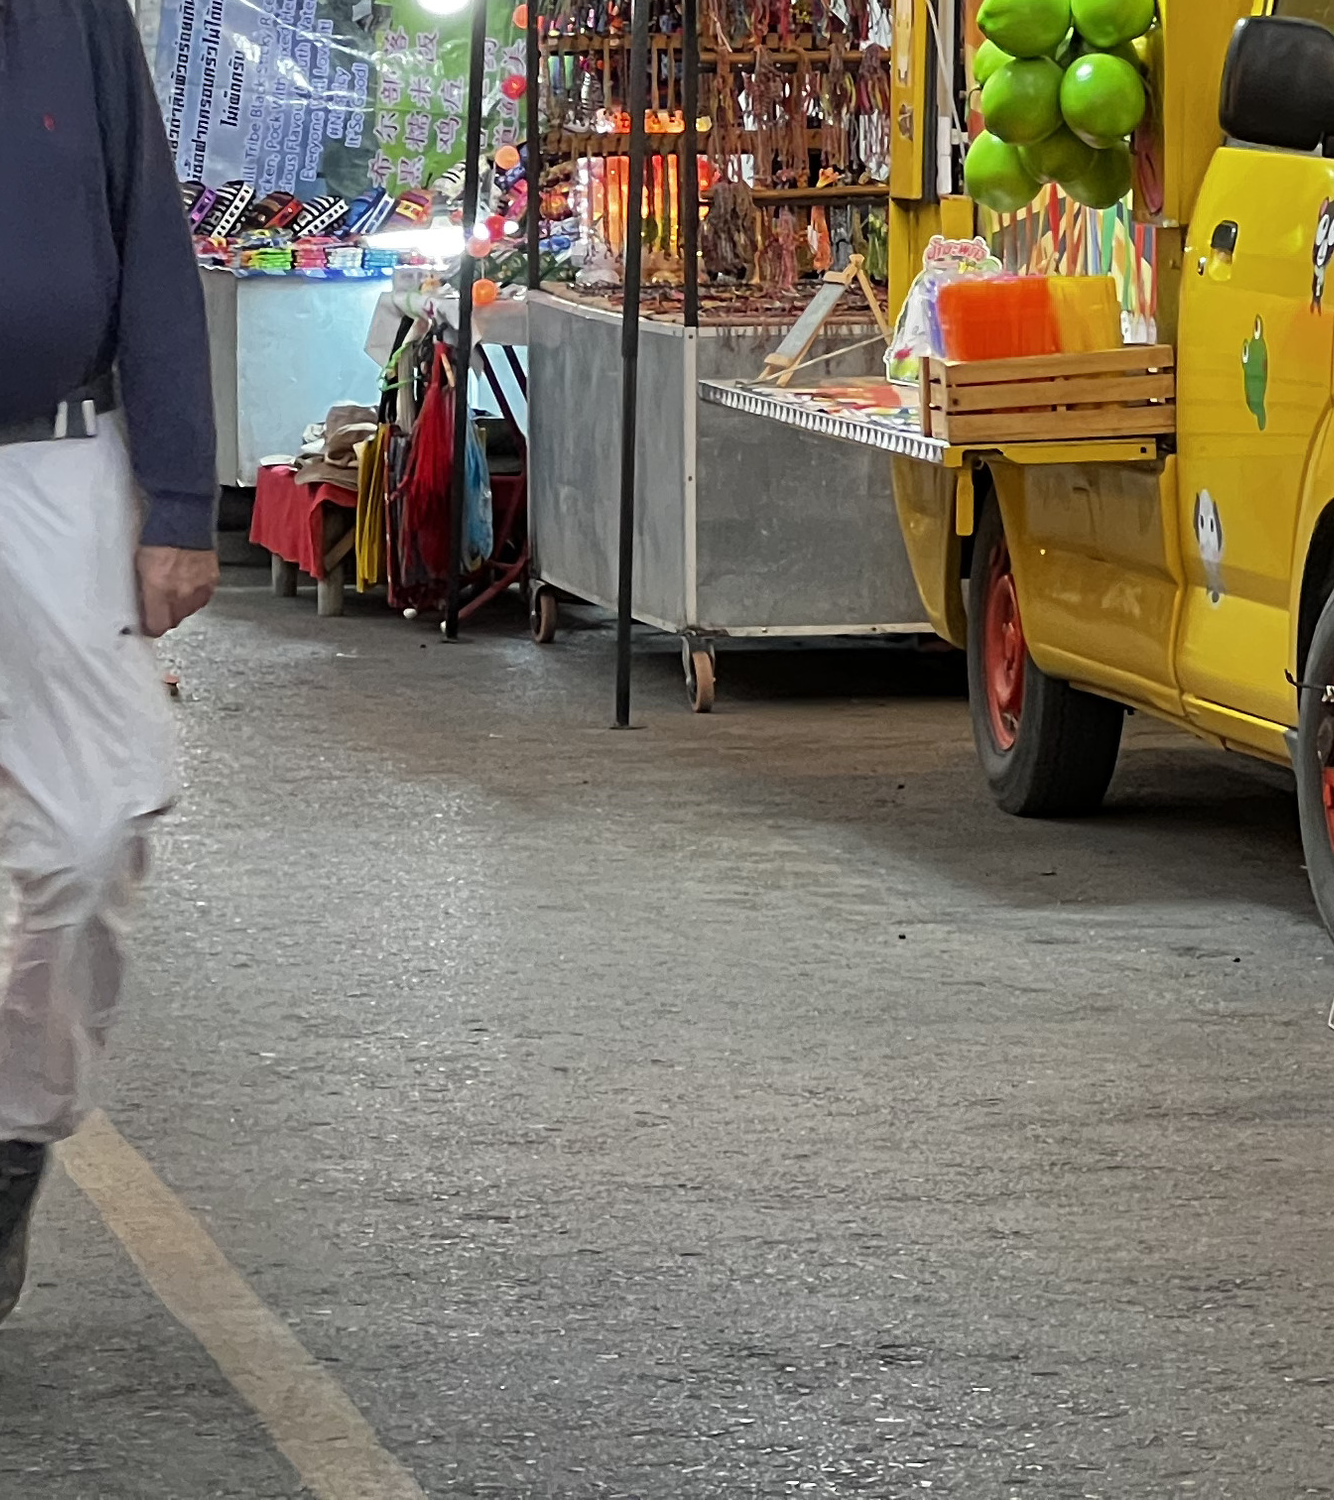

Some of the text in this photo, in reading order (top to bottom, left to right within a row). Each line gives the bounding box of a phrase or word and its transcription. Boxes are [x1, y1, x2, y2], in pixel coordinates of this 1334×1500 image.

[257, 31, 273, 73] Scky
[250, 80, 265, 117] Black
[272, 78, 286, 110] With
[352, 64, 367, 108] Good!
[303, 112, 324, 180] Everyone
[314, 41, 329, 76] Lov
[398, 30, 438, 186] 黑糯米饭
[246, 123, 261, 158] Tribe
[267, 116, 282, 149] Pock
[262, 155, 279, 192] cken,
